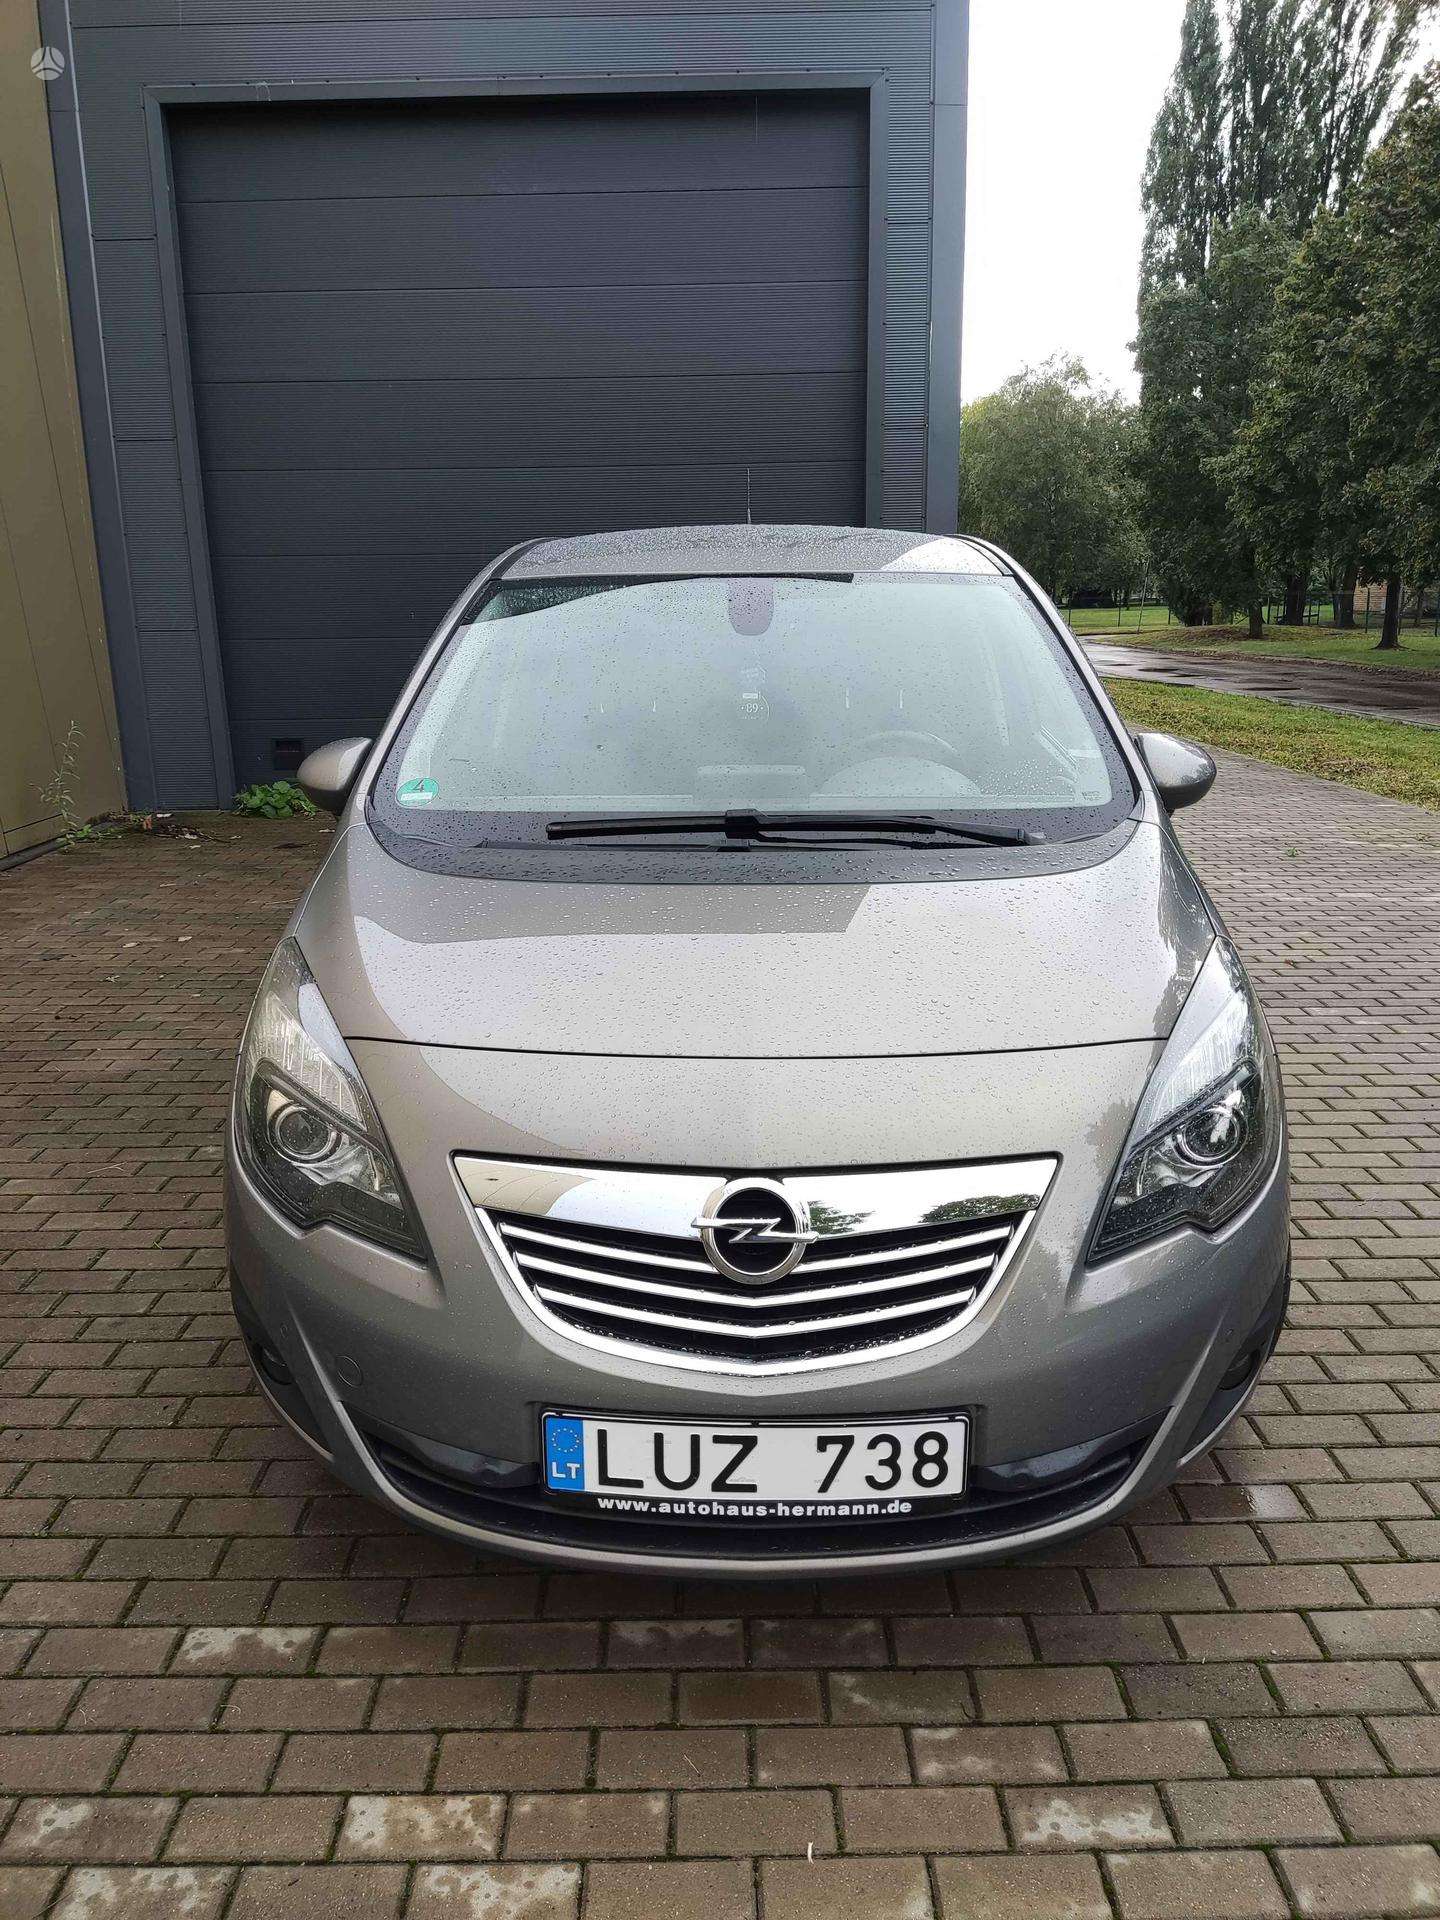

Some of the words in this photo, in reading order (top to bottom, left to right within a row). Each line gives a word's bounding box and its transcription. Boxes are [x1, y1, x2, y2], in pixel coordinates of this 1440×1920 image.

[412, 779, 425, 792] 4
[551, 1461, 580, 1479] LT
[597, 1429, 758, 1492] LUZ
[816, 1431, 949, 1493] 738
[597, 1497, 912, 1516] www.autohaus-hermann.de
